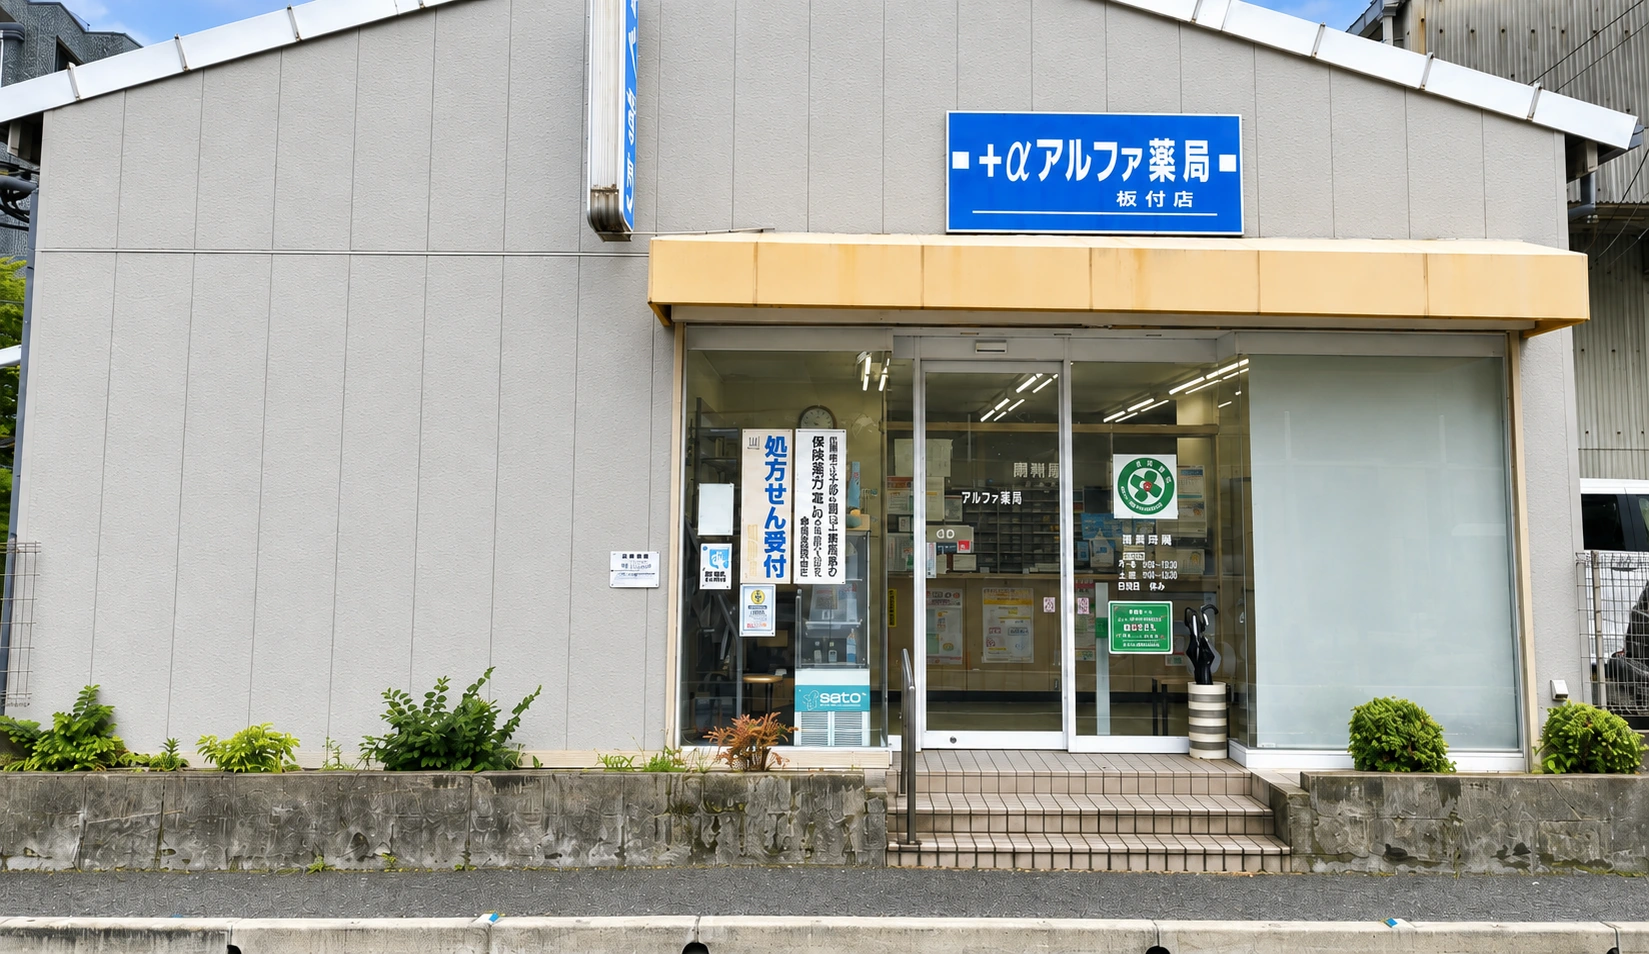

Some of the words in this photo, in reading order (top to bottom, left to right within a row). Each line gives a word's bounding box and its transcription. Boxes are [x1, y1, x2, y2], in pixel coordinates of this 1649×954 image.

[1116, 190, 1193, 208] 板付店
[961, 491, 1022, 505] アルファ薬局
[763, 435, 787, 578] 処方せん受付
[820, 692, 861, 703] sato
